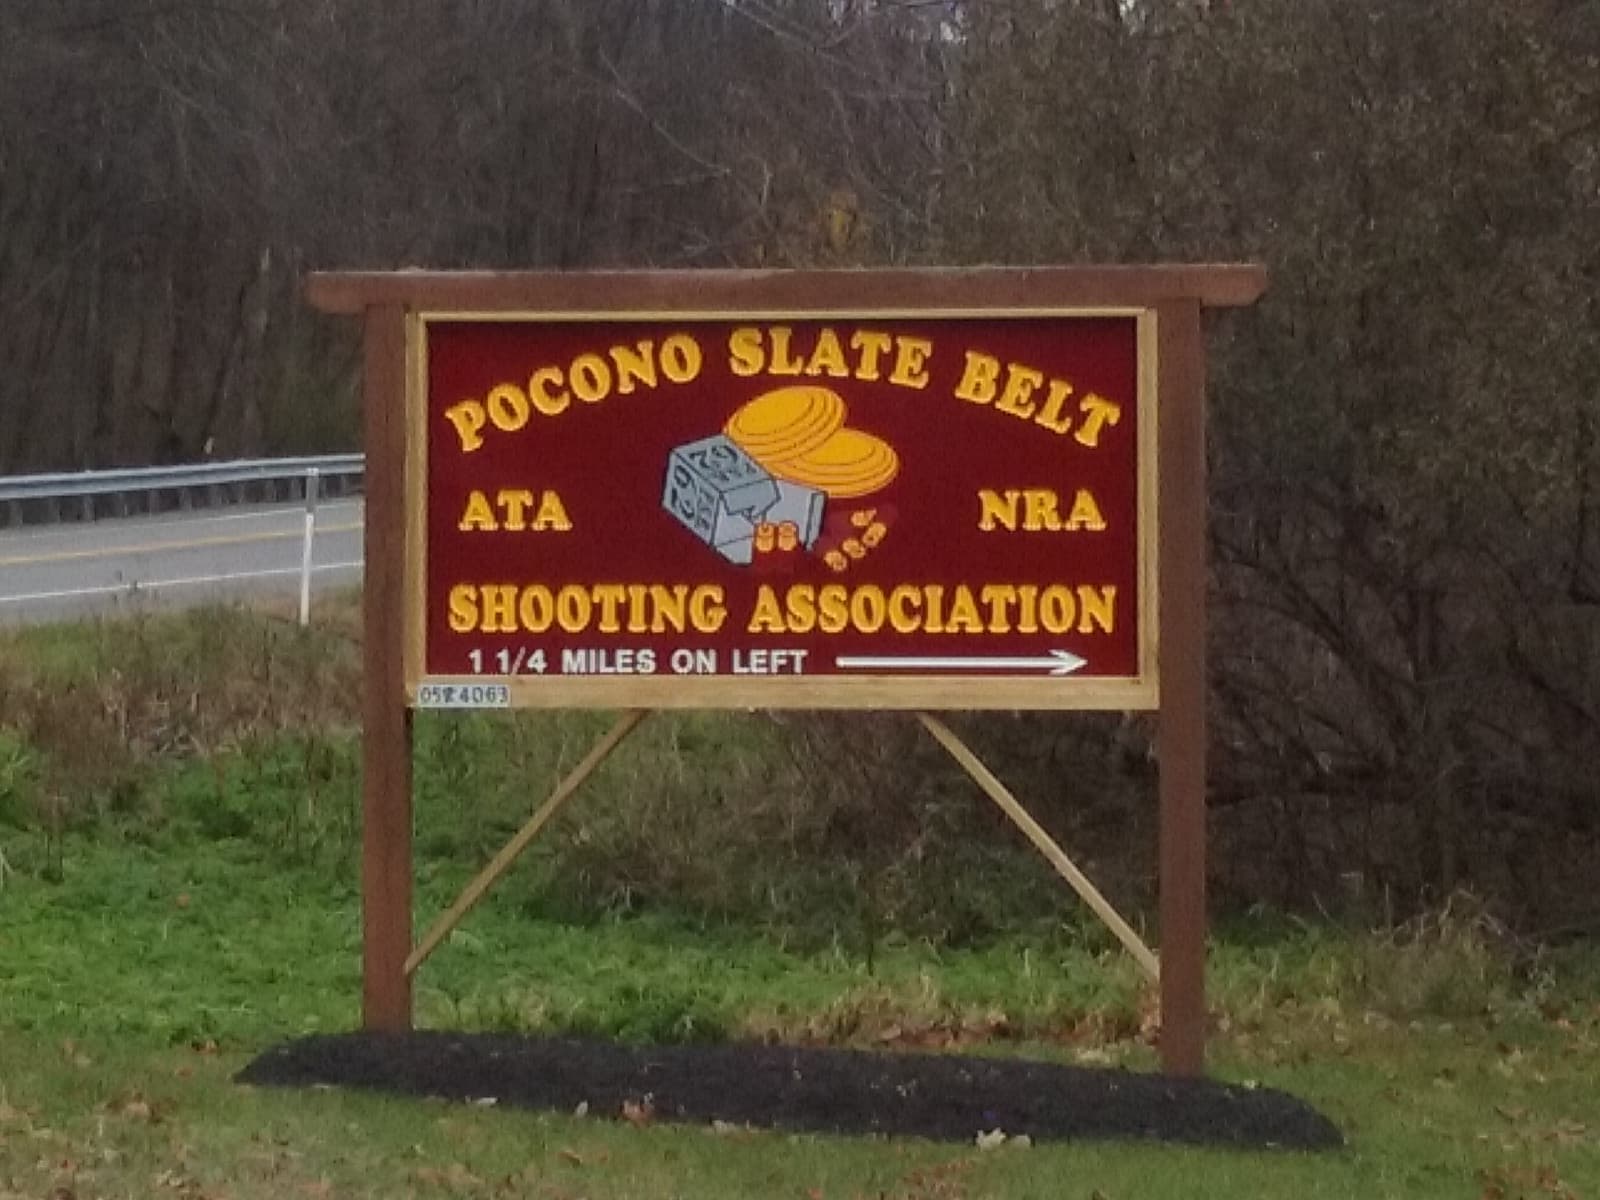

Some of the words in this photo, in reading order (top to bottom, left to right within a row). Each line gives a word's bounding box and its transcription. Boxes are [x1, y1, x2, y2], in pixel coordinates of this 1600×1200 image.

[445, 333, 703, 453] POCONO
[729, 327, 933, 390] SLATE
[954, 349, 1121, 449] BELT
[458, 489, 571, 533] ATA
[978, 489, 1107, 532] NRA
[448, 584, 726, 635] SHOOTING
[748, 584, 1117, 636] ASSOCIATION
[468, 648, 482, 674] 1
[496, 646, 548, 675] 1/4
[561, 648, 656, 674] MILES
[671, 648, 717, 674] ON
[732, 648, 809, 674] LEFT
